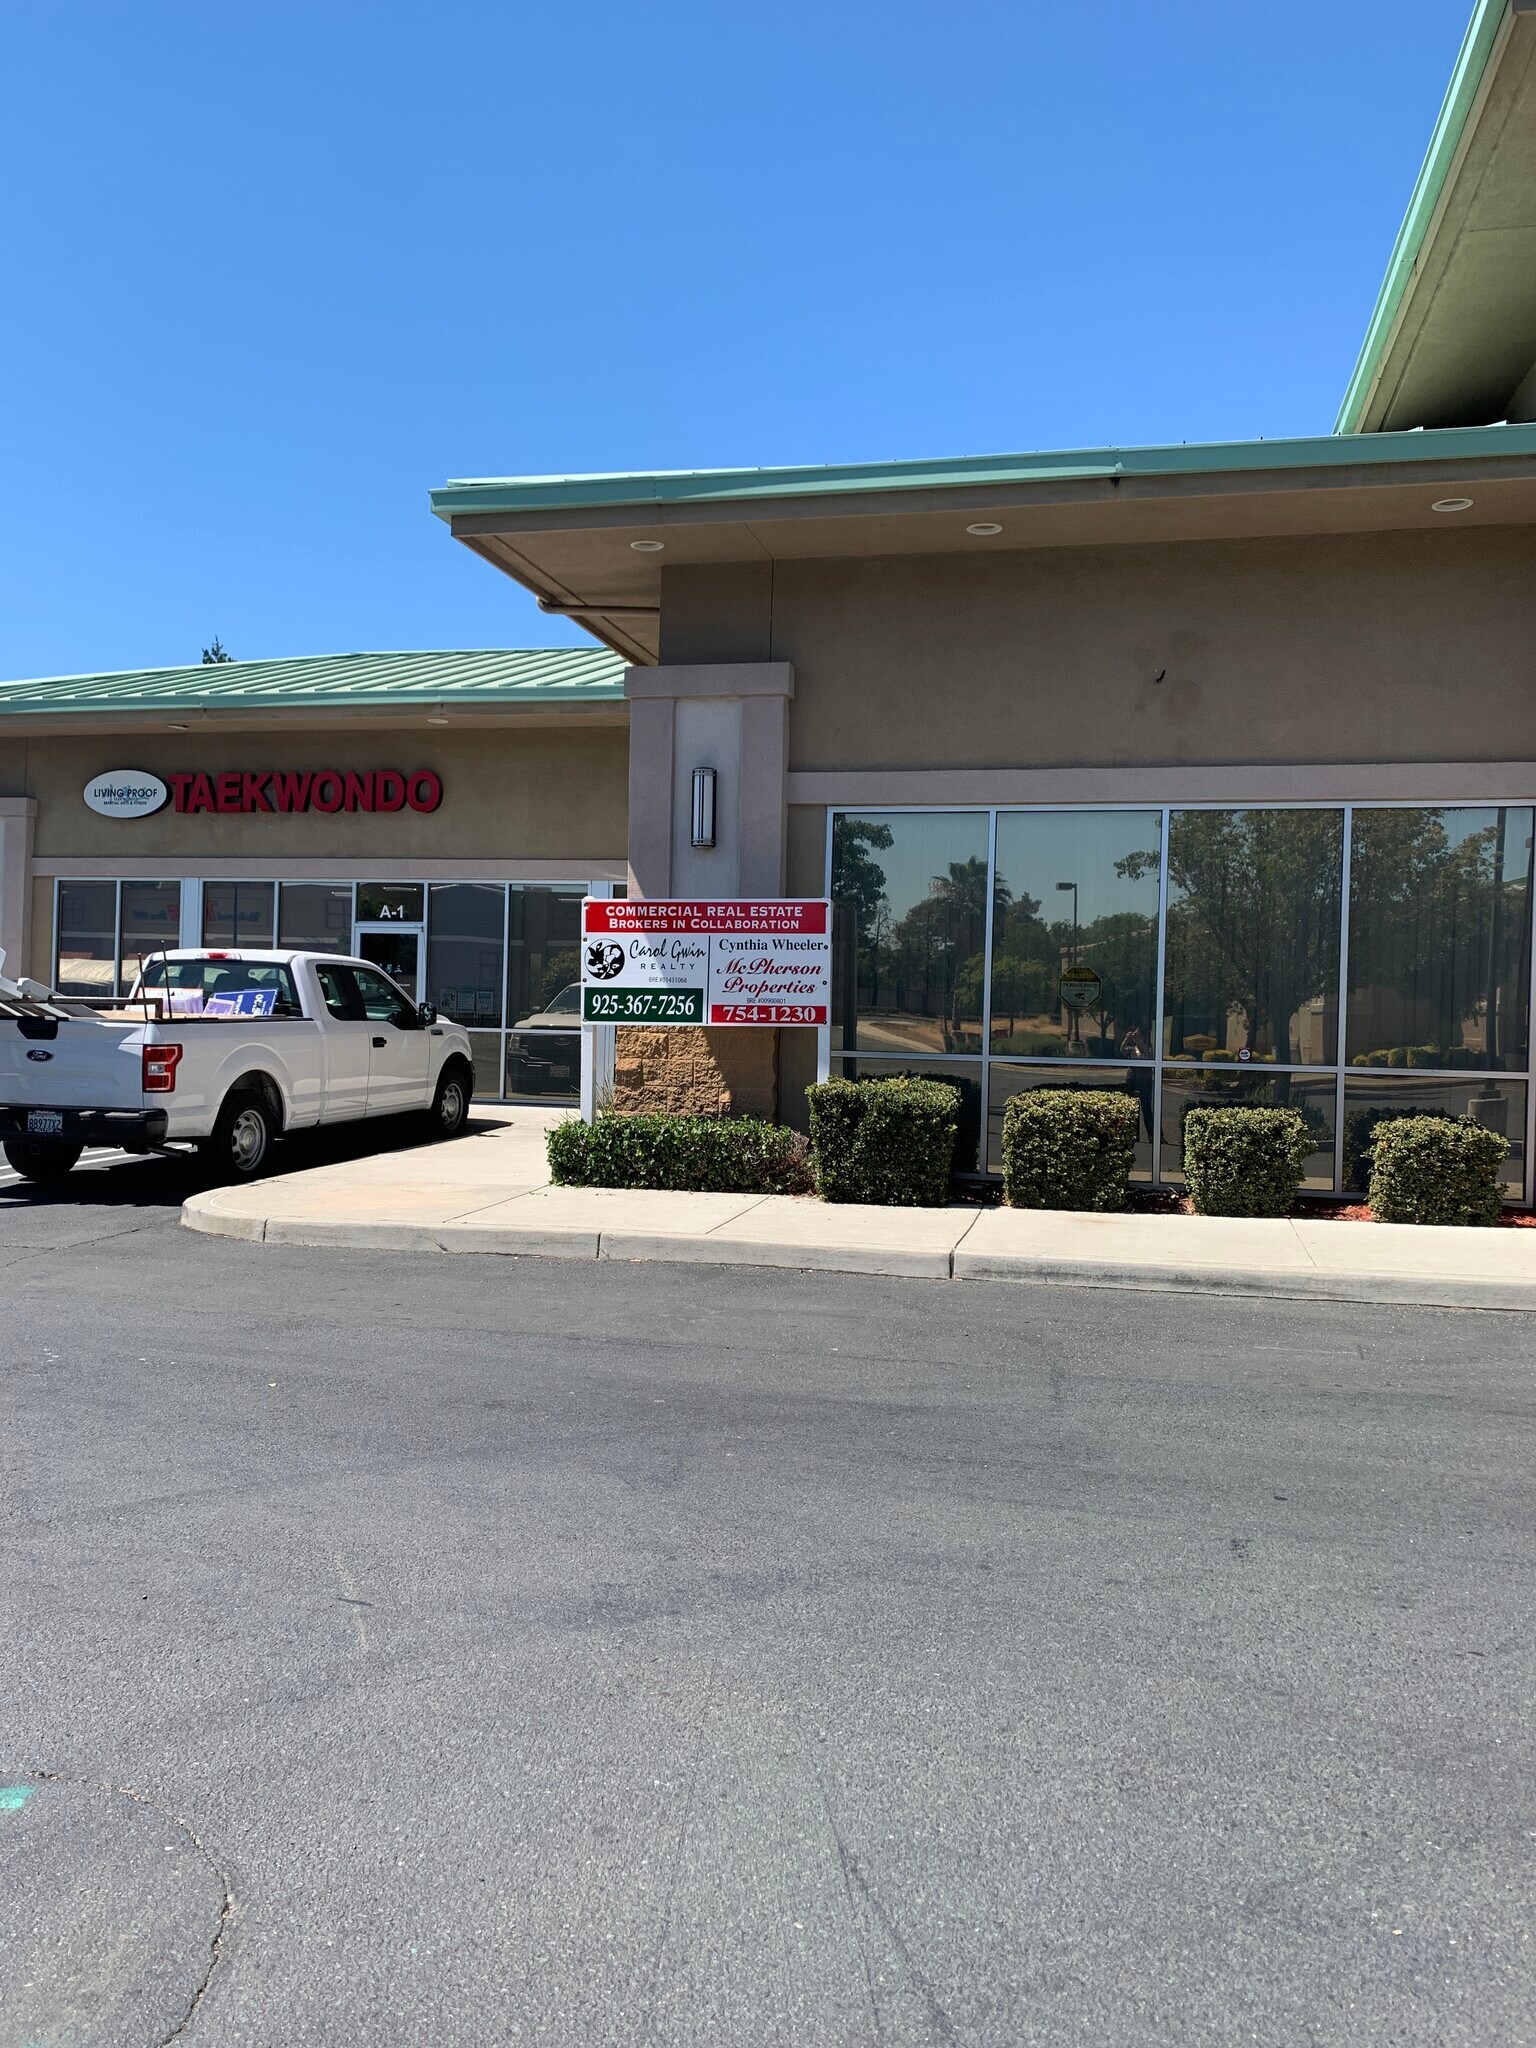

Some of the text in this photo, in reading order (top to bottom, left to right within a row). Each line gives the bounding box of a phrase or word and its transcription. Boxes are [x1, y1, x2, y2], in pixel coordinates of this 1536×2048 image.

[94, 788, 158, 798] LIVING PROOF
[168, 770, 442, 813] TAEKWONDO
[379, 904, 404, 919] A-1
[605, 905, 803, 918] COMMERCIAL REAL ESTATE
[672, 919, 686, 929] IN
[629, 938, 707, 963] Carol Gwin
[719, 938, 823, 953] Cynthia Wheeler
[640, 962, 696, 970] REALTY
[722, 976, 818, 998] Properties
[591, 993, 696, 1016] 925-367-7256
[722, 1006, 817, 1023] 754-1230
